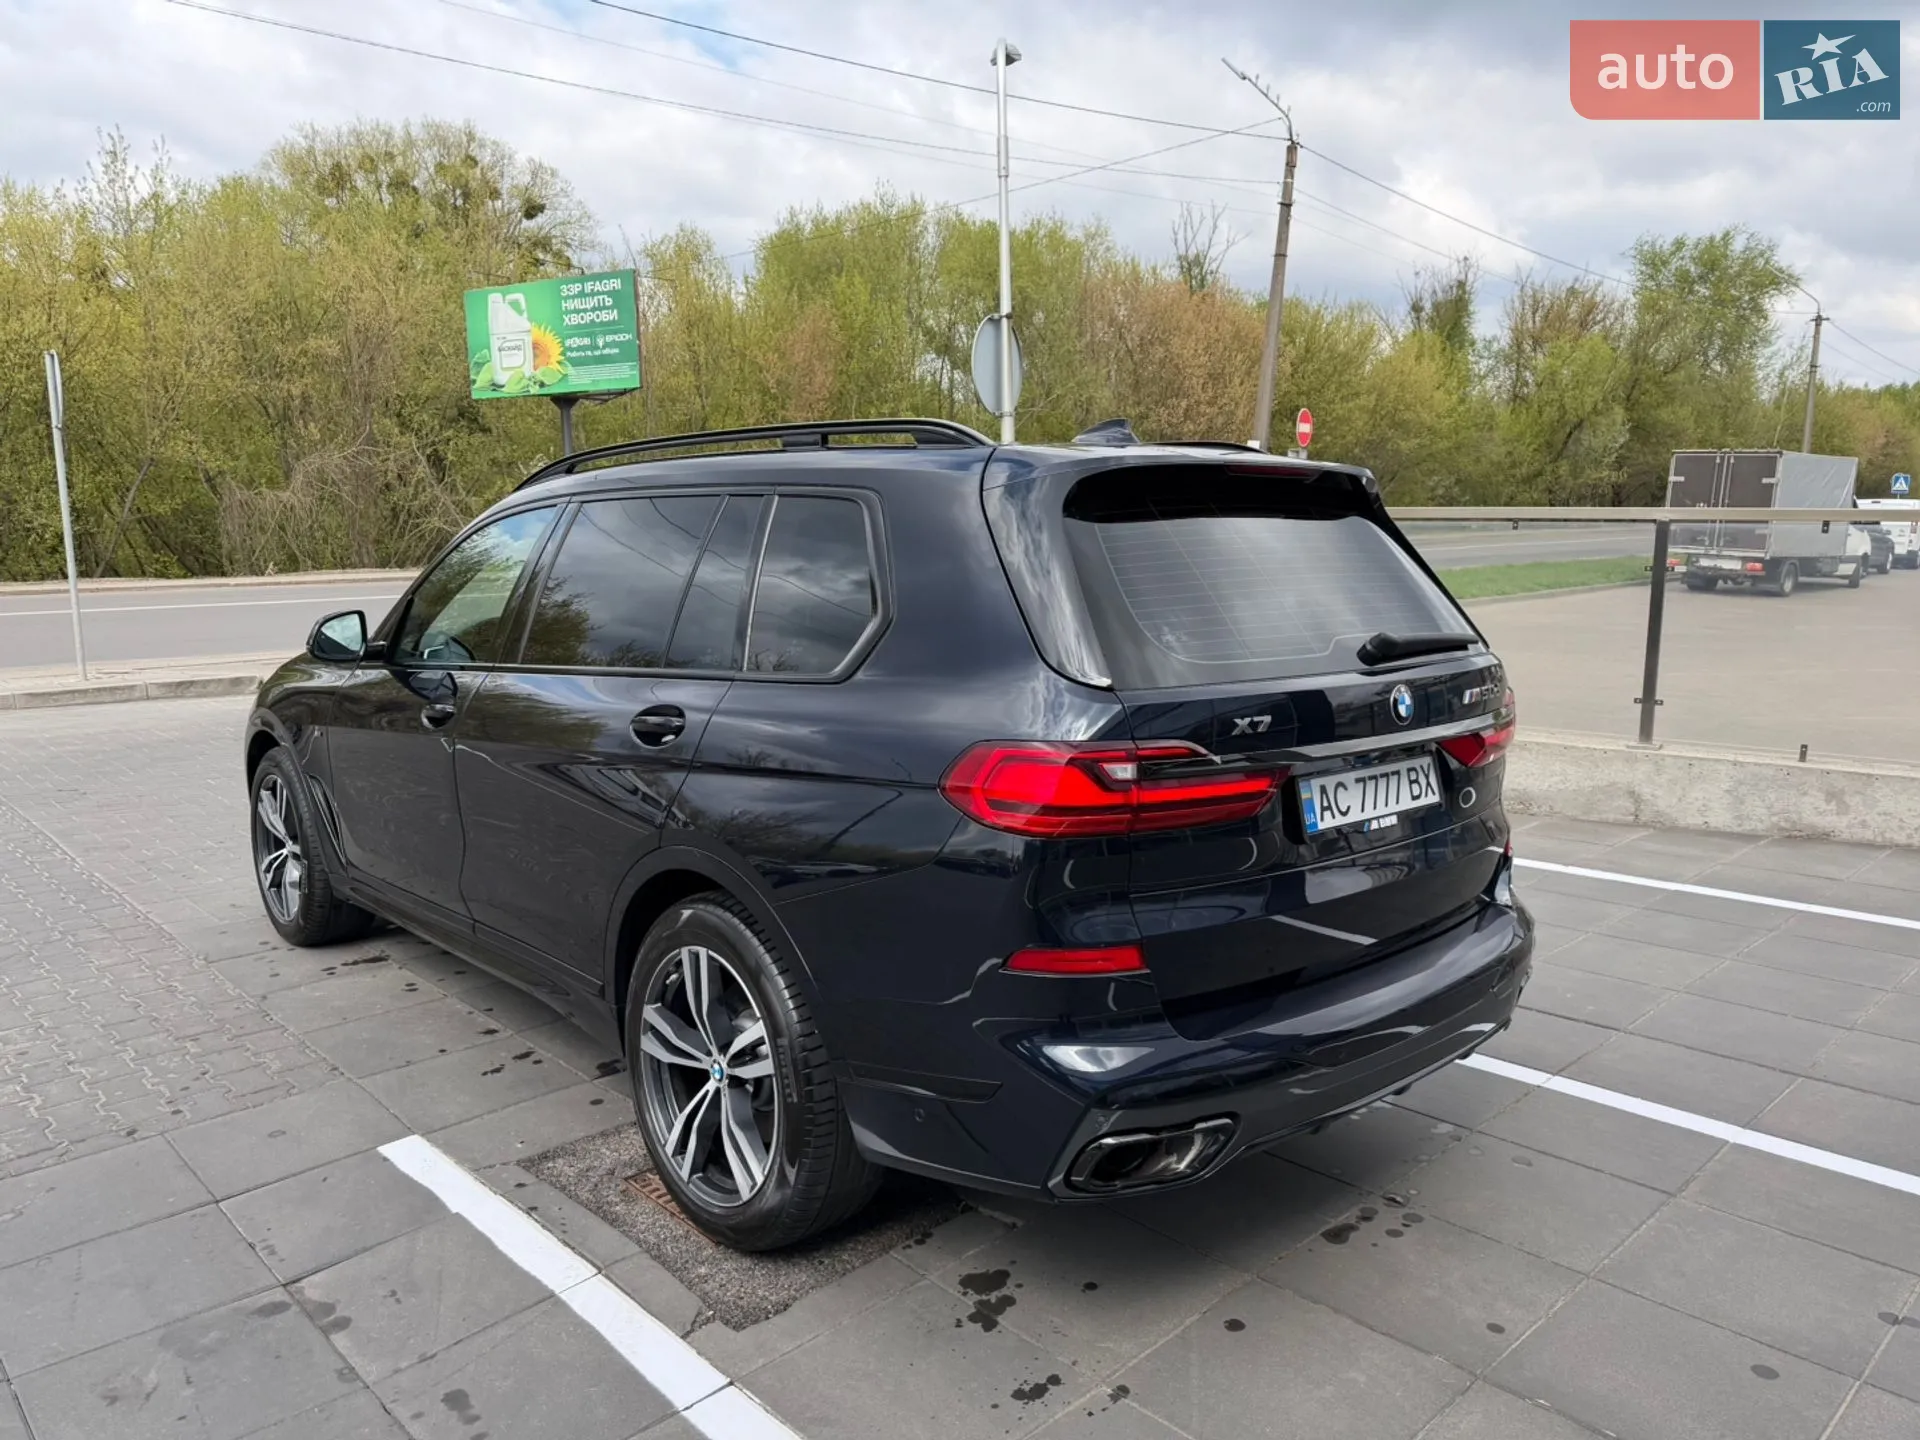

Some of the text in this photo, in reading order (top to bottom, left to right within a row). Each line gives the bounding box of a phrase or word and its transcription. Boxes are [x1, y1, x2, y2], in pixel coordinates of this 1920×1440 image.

[560, 278, 622, 297] ЗЗР IFAGRI
[561, 295, 613, 311] НИЩИТЬ
[562, 309, 618, 326] ХВОРОБИ
[1231, 714, 1272, 736] X7
[1320, 762, 1436, 822] AC 7777 BX
[1304, 814, 1316, 825] UA
